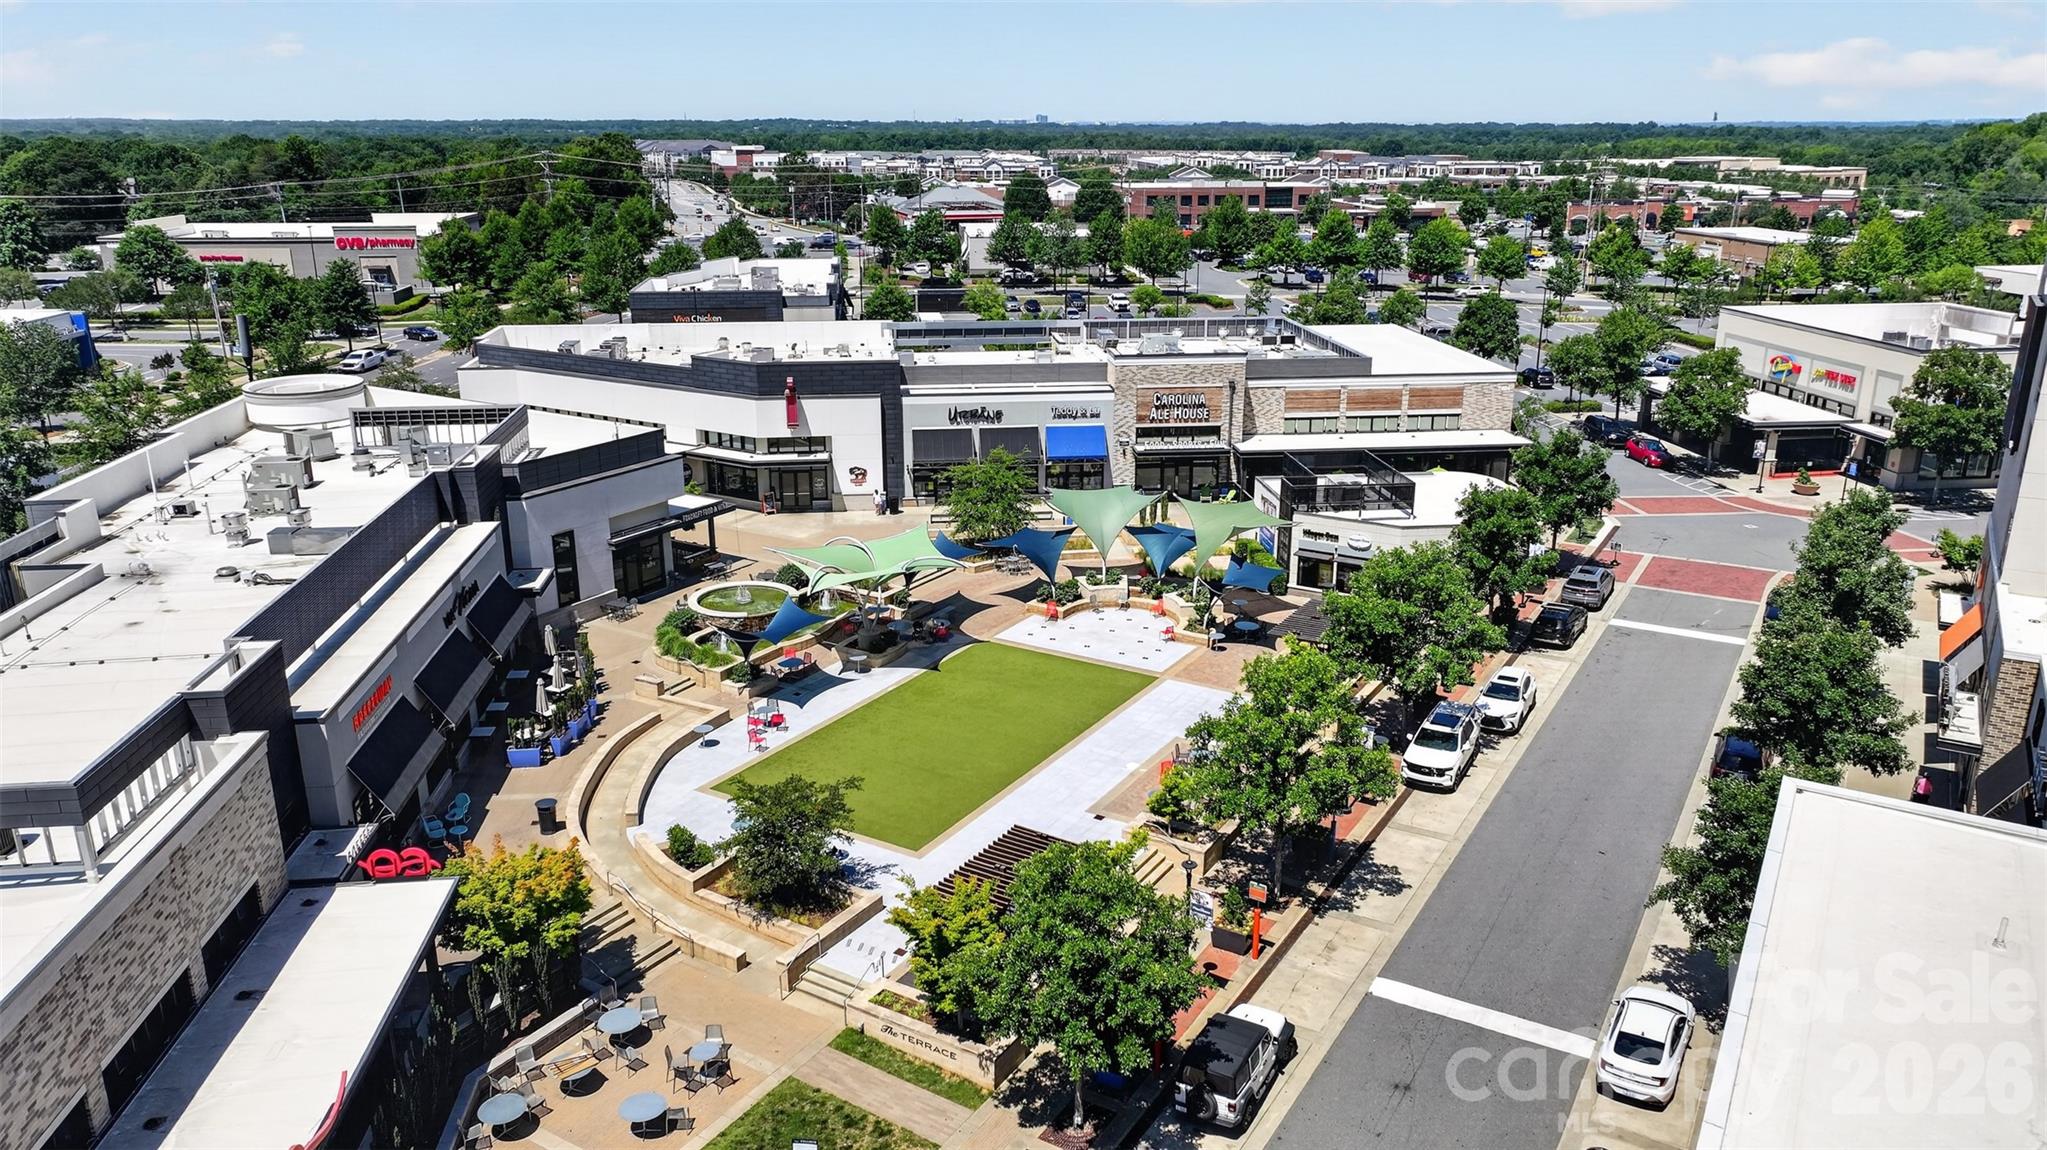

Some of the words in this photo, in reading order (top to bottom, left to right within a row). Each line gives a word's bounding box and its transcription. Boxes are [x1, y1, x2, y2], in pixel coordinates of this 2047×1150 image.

[1153, 392, 1206, 406] CAROLINA
[1150, 407, 1170, 420] ALE
[1174, 406, 1210, 419] HOUSE
[880, 1024, 899, 1038] The
[901, 1032, 958, 1061] TERRACE
